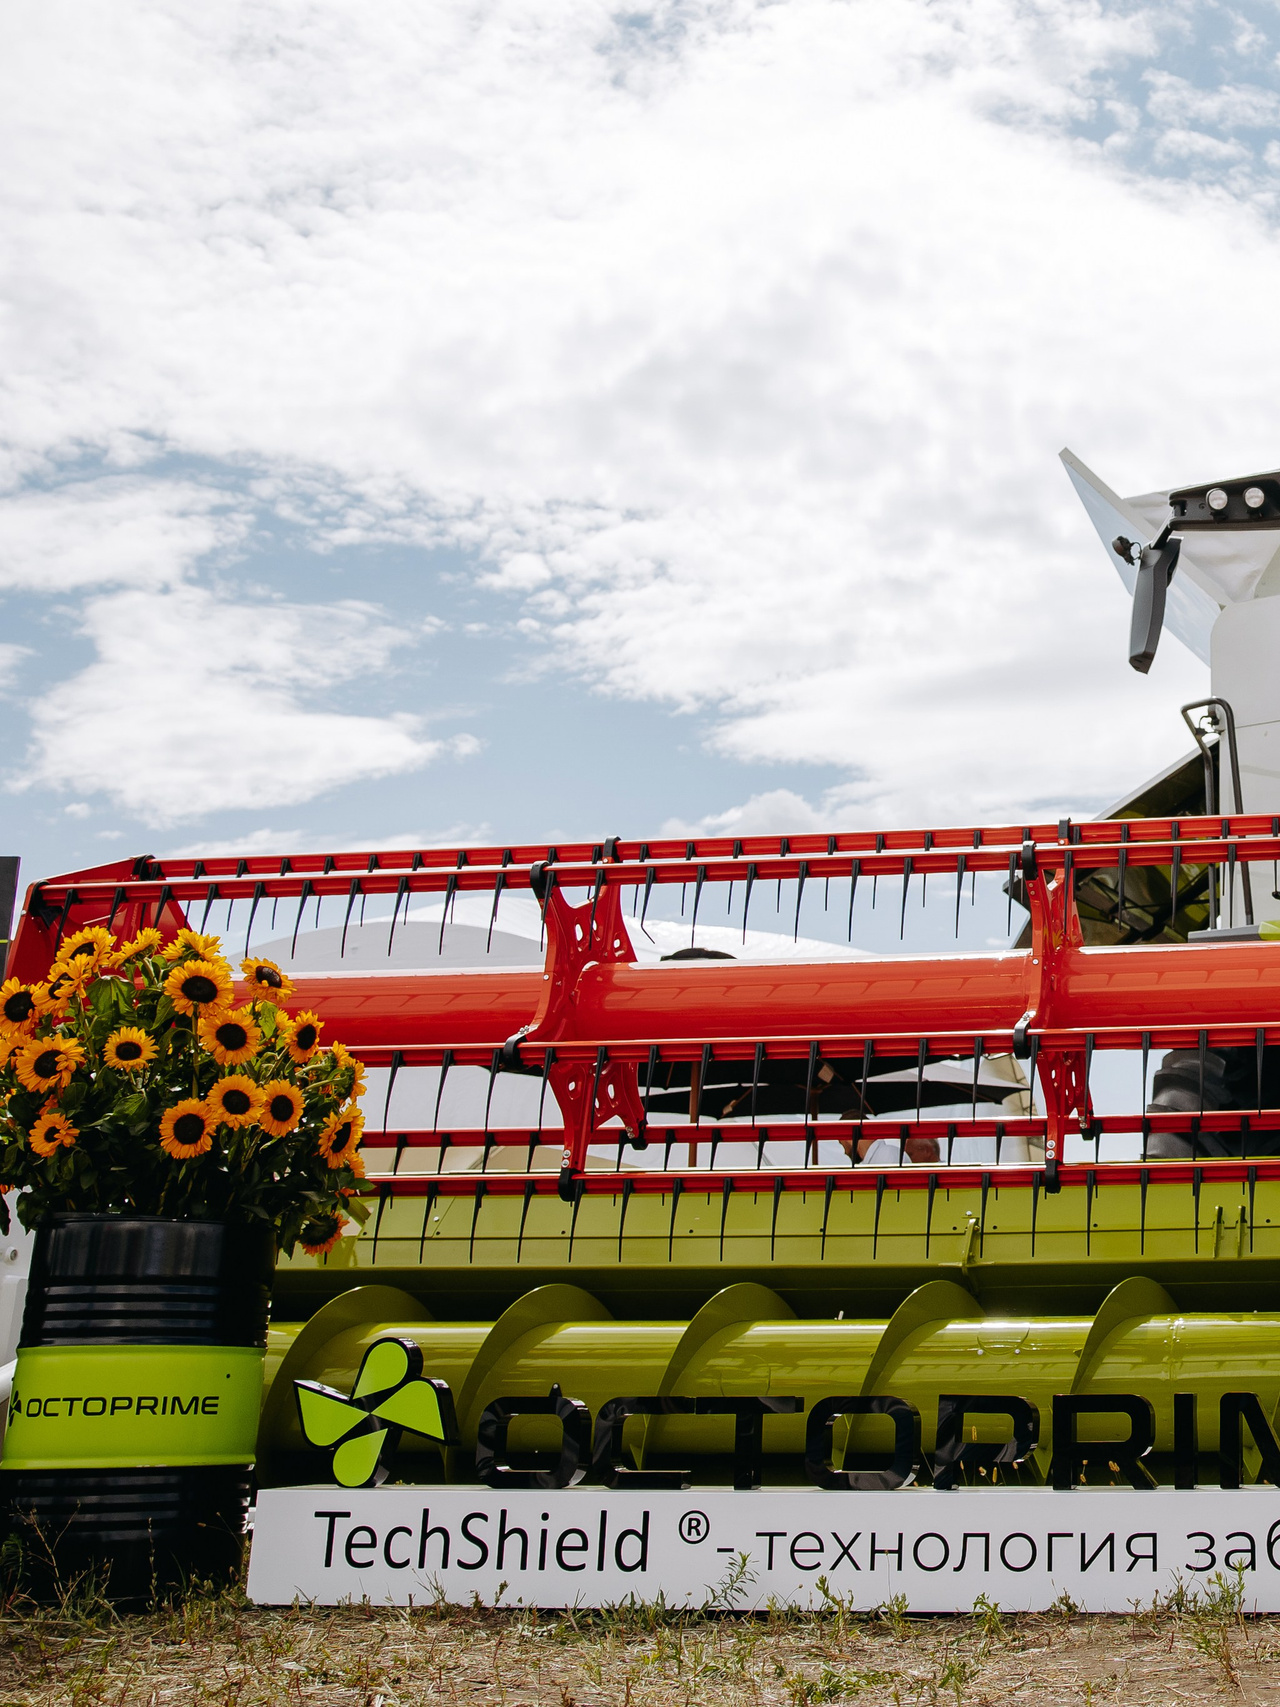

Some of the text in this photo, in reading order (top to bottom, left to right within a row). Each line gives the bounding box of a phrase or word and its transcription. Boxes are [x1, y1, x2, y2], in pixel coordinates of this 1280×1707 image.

[25, 1396, 220, 1418] OCTOPRIME
[314, 1508, 650, 1573] TechShield
[755, 1531, 1158, 1573] технология
